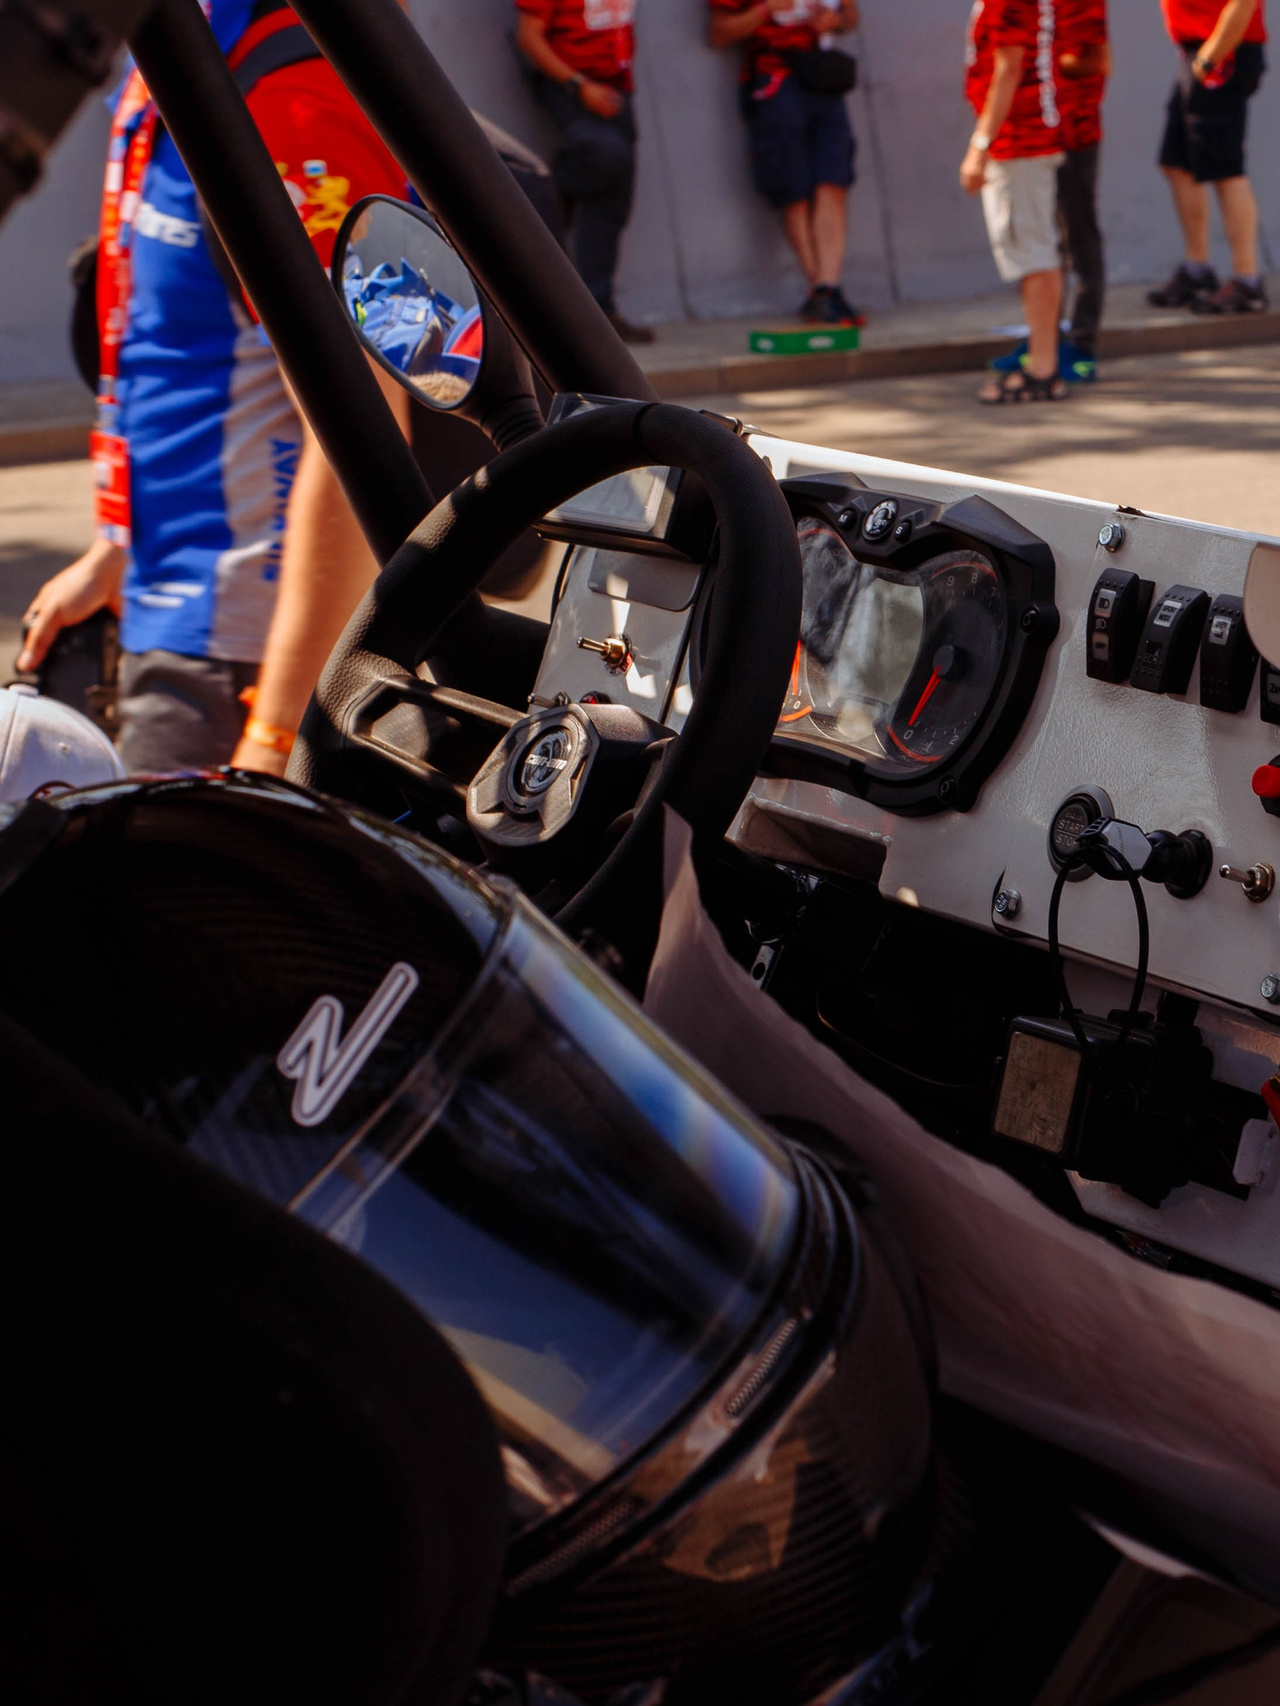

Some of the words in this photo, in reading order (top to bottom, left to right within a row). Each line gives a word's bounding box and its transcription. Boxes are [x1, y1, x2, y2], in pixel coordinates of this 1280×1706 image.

[971, 572, 979, 584] 8
[903, 729, 914, 740] 0
[1057, 819, 1085, 833] START
